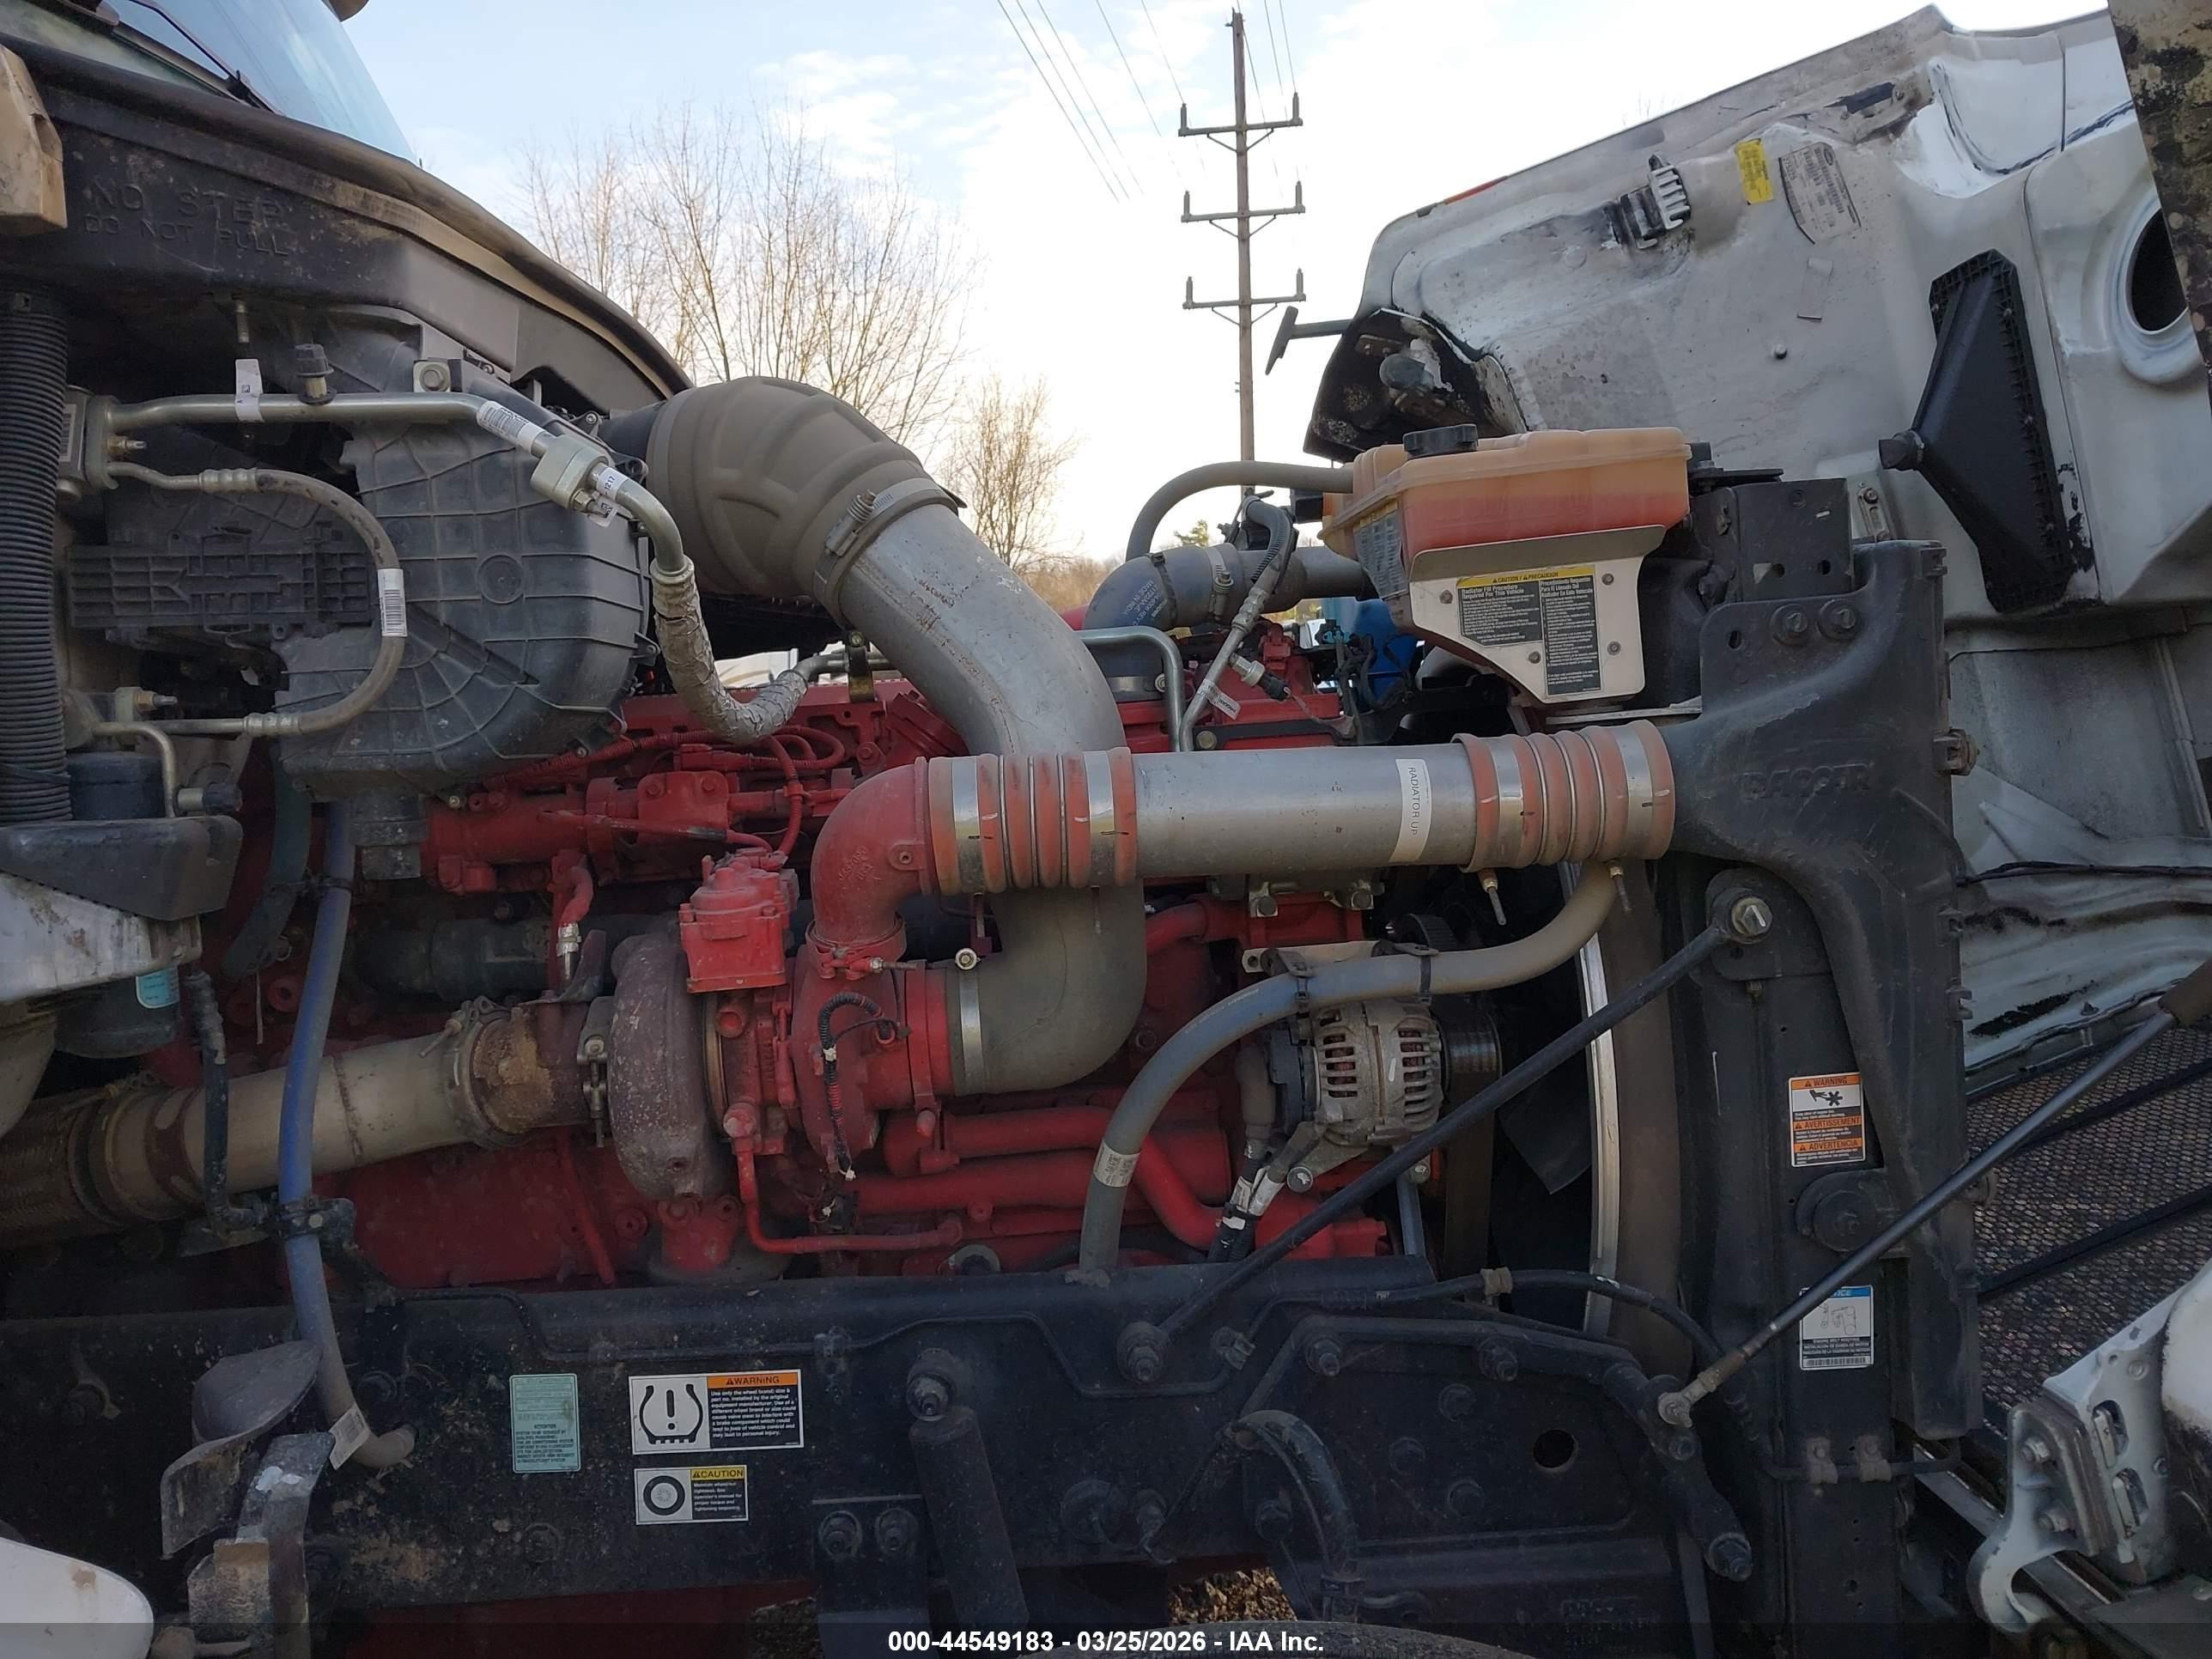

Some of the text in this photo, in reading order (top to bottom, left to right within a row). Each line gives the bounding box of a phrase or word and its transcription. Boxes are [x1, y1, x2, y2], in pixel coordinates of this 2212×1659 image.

[87, 177, 284, 227] NO STEP
[141, 217, 194, 243] NOT
[217, 228, 289, 257] PULL
[1408, 767, 1420, 836] RADIATOR UP
[1814, 1078, 1847, 1086] WARNING
[1804, 1116, 1860, 1128] AVERTISSEMENT
[1809, 1139, 1857, 1150] ADVERTENCIA
[734, 1376, 780, 1385] WARNING
[701, 1469, 744, 1479] CAUTION
